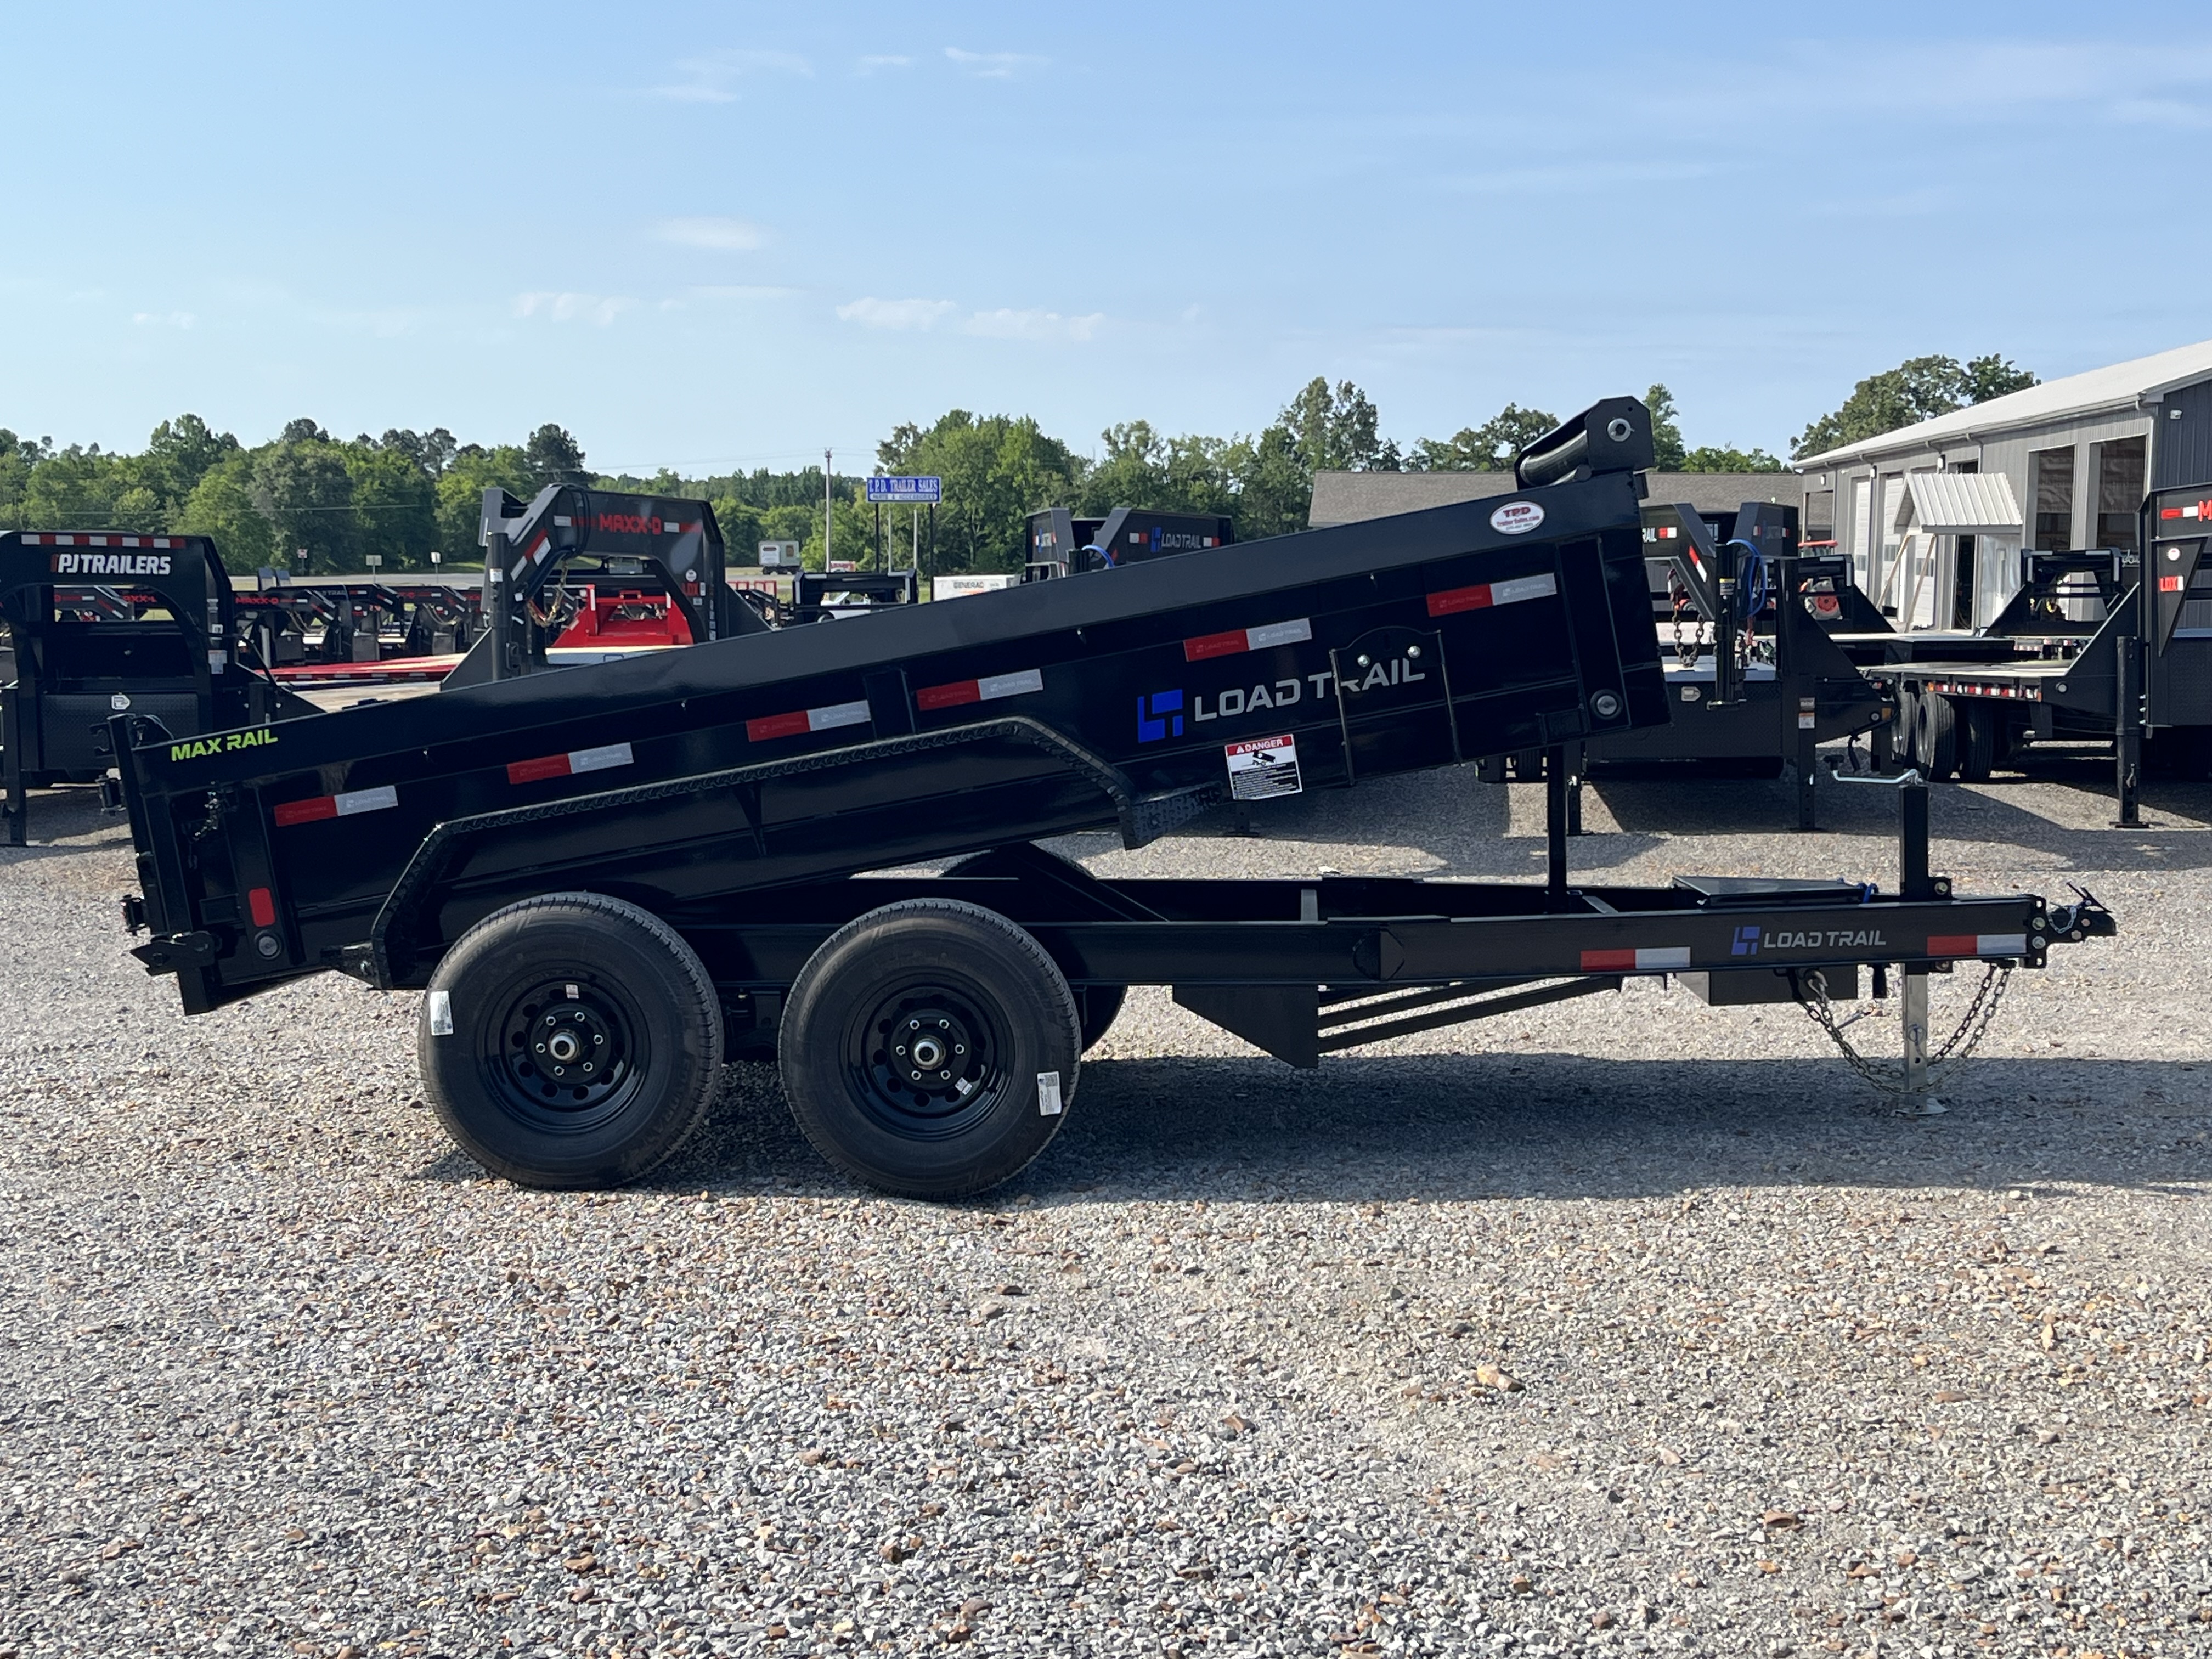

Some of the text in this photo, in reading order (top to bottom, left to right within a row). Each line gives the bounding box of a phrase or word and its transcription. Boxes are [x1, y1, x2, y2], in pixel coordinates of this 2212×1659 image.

[890, 479, 916, 492] TRAILER
[918, 479, 938, 492] SALES
[1503, 506, 1531, 517] TPD
[1161, 533, 1201, 549] LOAD TRAIL
[58, 554, 172, 575] PJ TRAILERS
[1194, 678, 1301, 722] LOAD
[171, 729, 278, 761] MAX RAIL
[1244, 738, 1283, 752] DANGER
[1763, 930, 1887, 948] LOAD TRAIL
